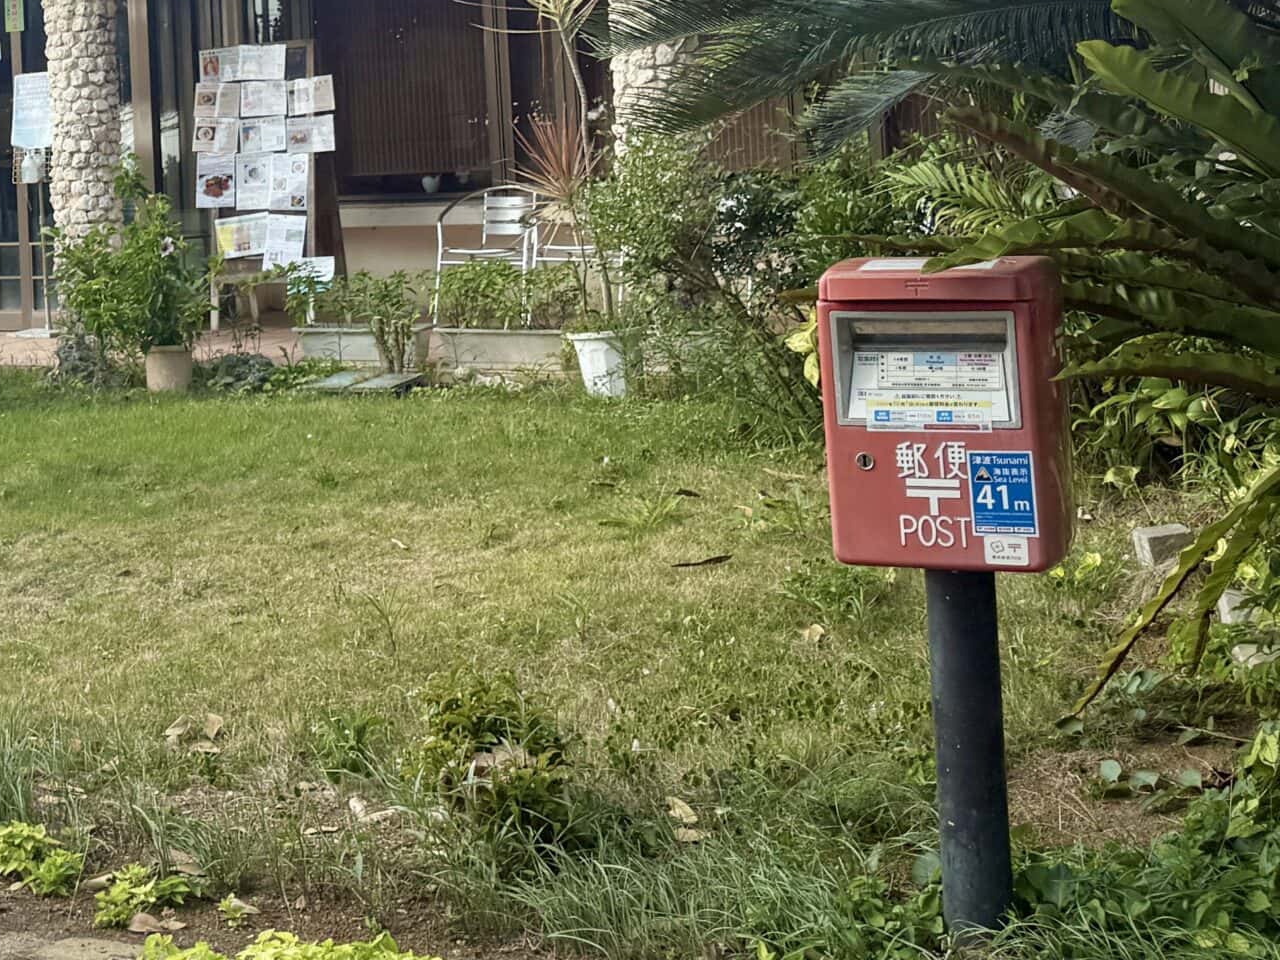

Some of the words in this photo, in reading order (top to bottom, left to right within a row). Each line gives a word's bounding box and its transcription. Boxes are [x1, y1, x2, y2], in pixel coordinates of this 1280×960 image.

[896, 441, 968, 479] 郵便
[992, 455, 1028, 465] Tsunami
[976, 484, 1009, 510] 41
[1014, 500, 1030, 511] m
[899, 515, 971, 548] POST
